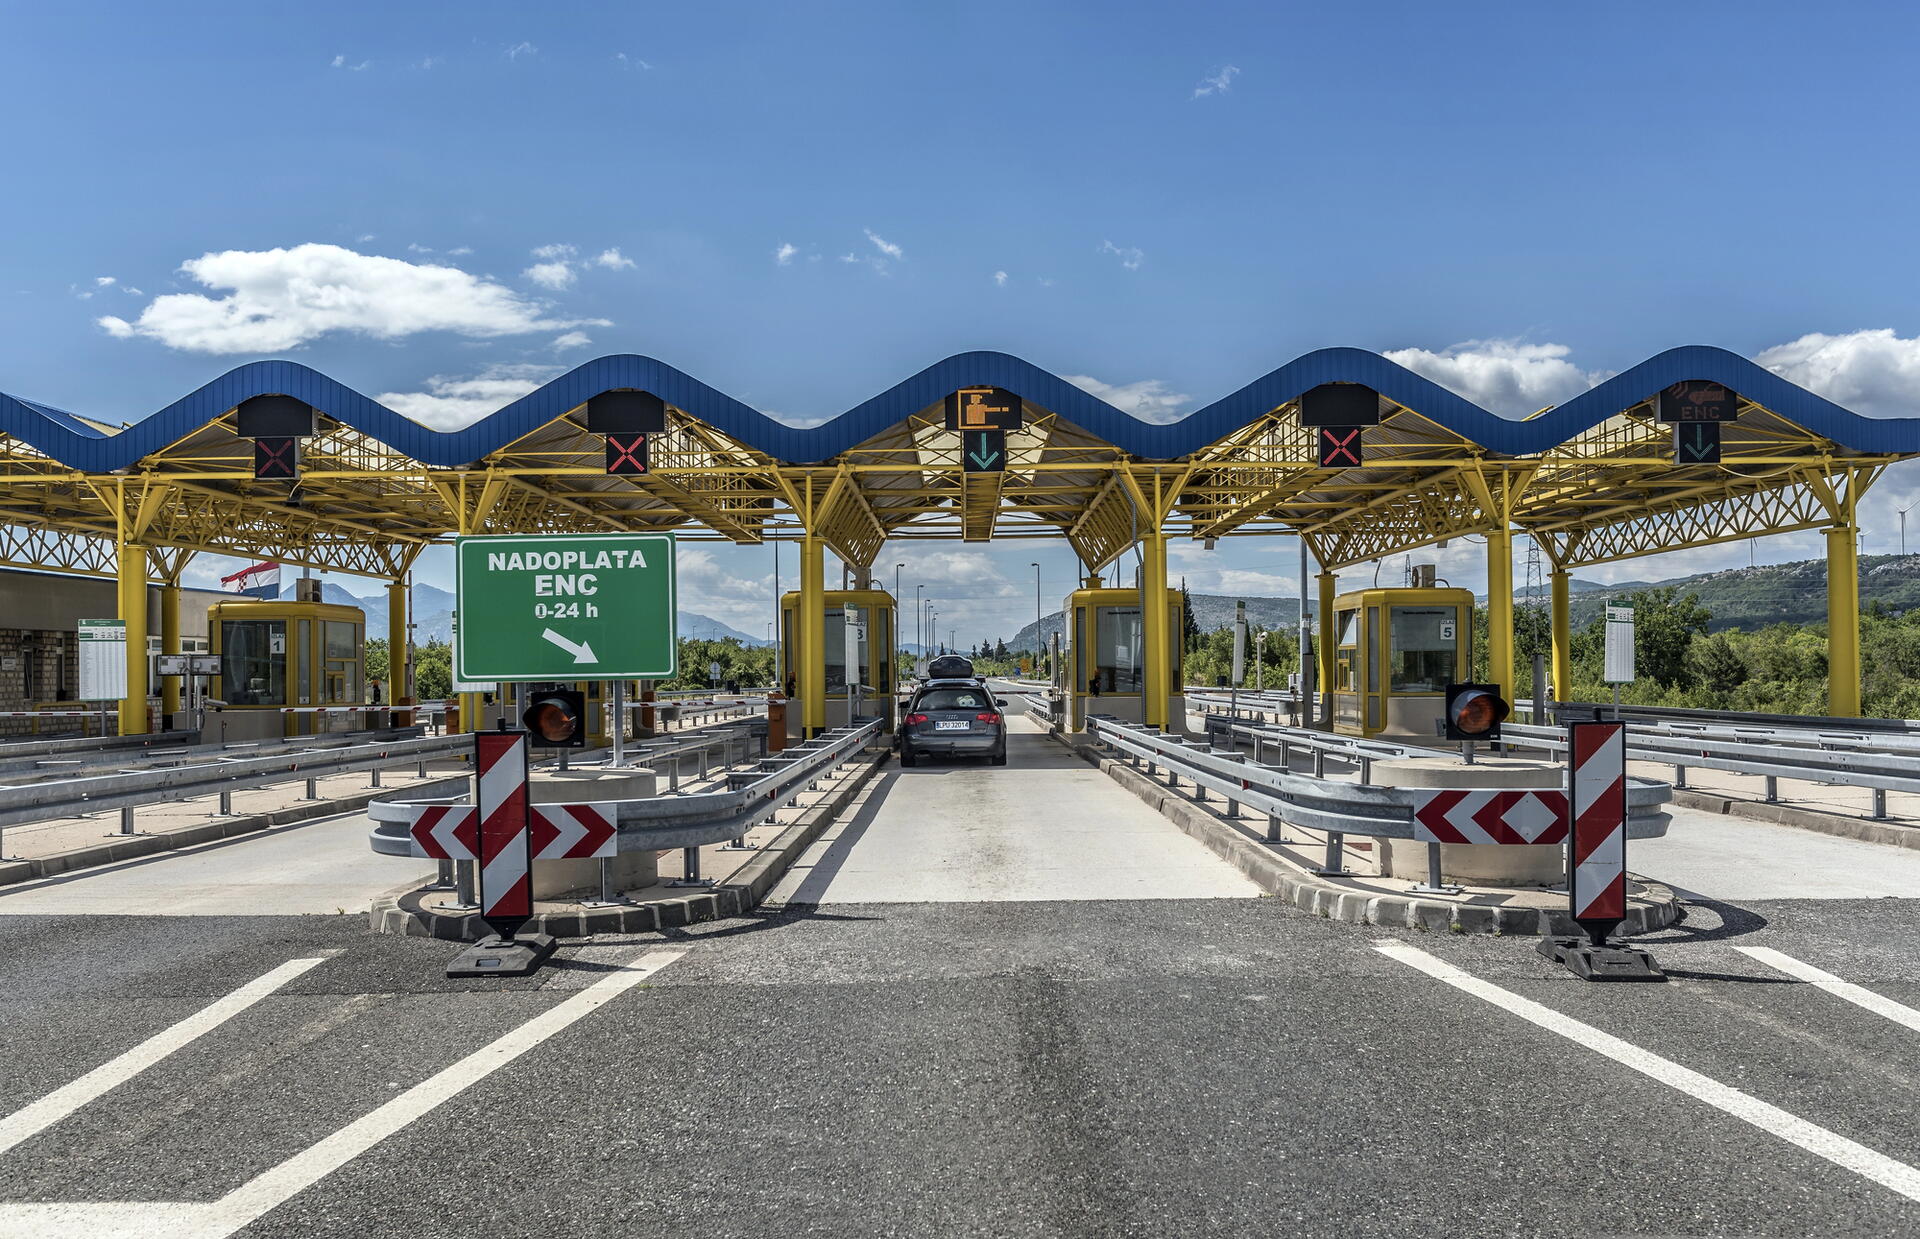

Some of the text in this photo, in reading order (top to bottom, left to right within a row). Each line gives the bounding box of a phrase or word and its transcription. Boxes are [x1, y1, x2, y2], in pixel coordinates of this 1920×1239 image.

[1681, 406, 1720, 420] ENC
[488, 549, 647, 571] NADOPLATA
[535, 573, 598, 597] ENC
[535, 602, 598, 619] 0-24 h
[1444, 627, 1452, 638] 5
[273, 640, 280, 652] 1
